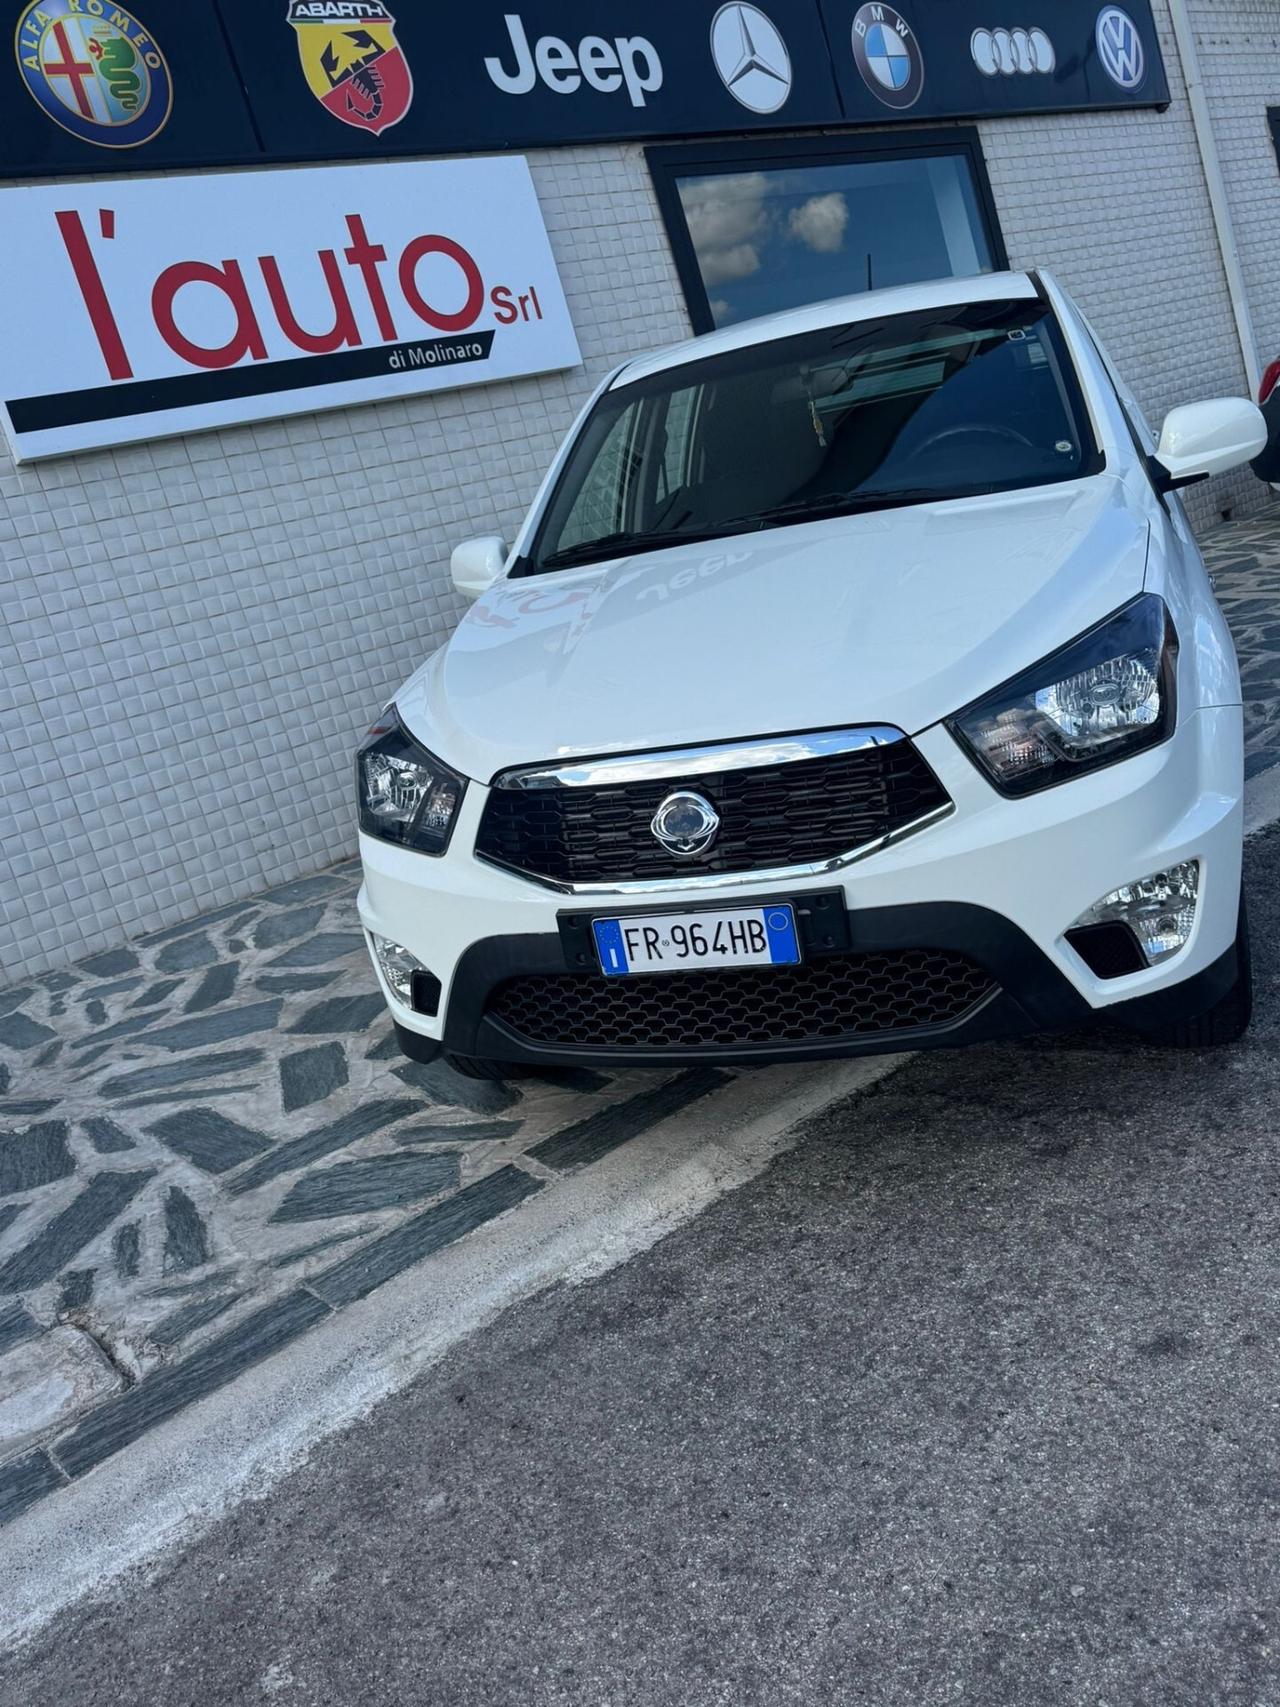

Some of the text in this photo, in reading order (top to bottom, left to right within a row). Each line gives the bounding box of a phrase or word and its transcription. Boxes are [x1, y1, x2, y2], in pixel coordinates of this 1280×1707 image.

[295, 2, 383, 16] ABARTH
[854, 6, 909, 37] BMW
[22, 0, 161, 72] ALFA ROMEO
[484, 14, 663, 107] Jeep
[54, 209, 543, 380] l'auto Srl
[388, 343, 482, 370] di Molinaro
